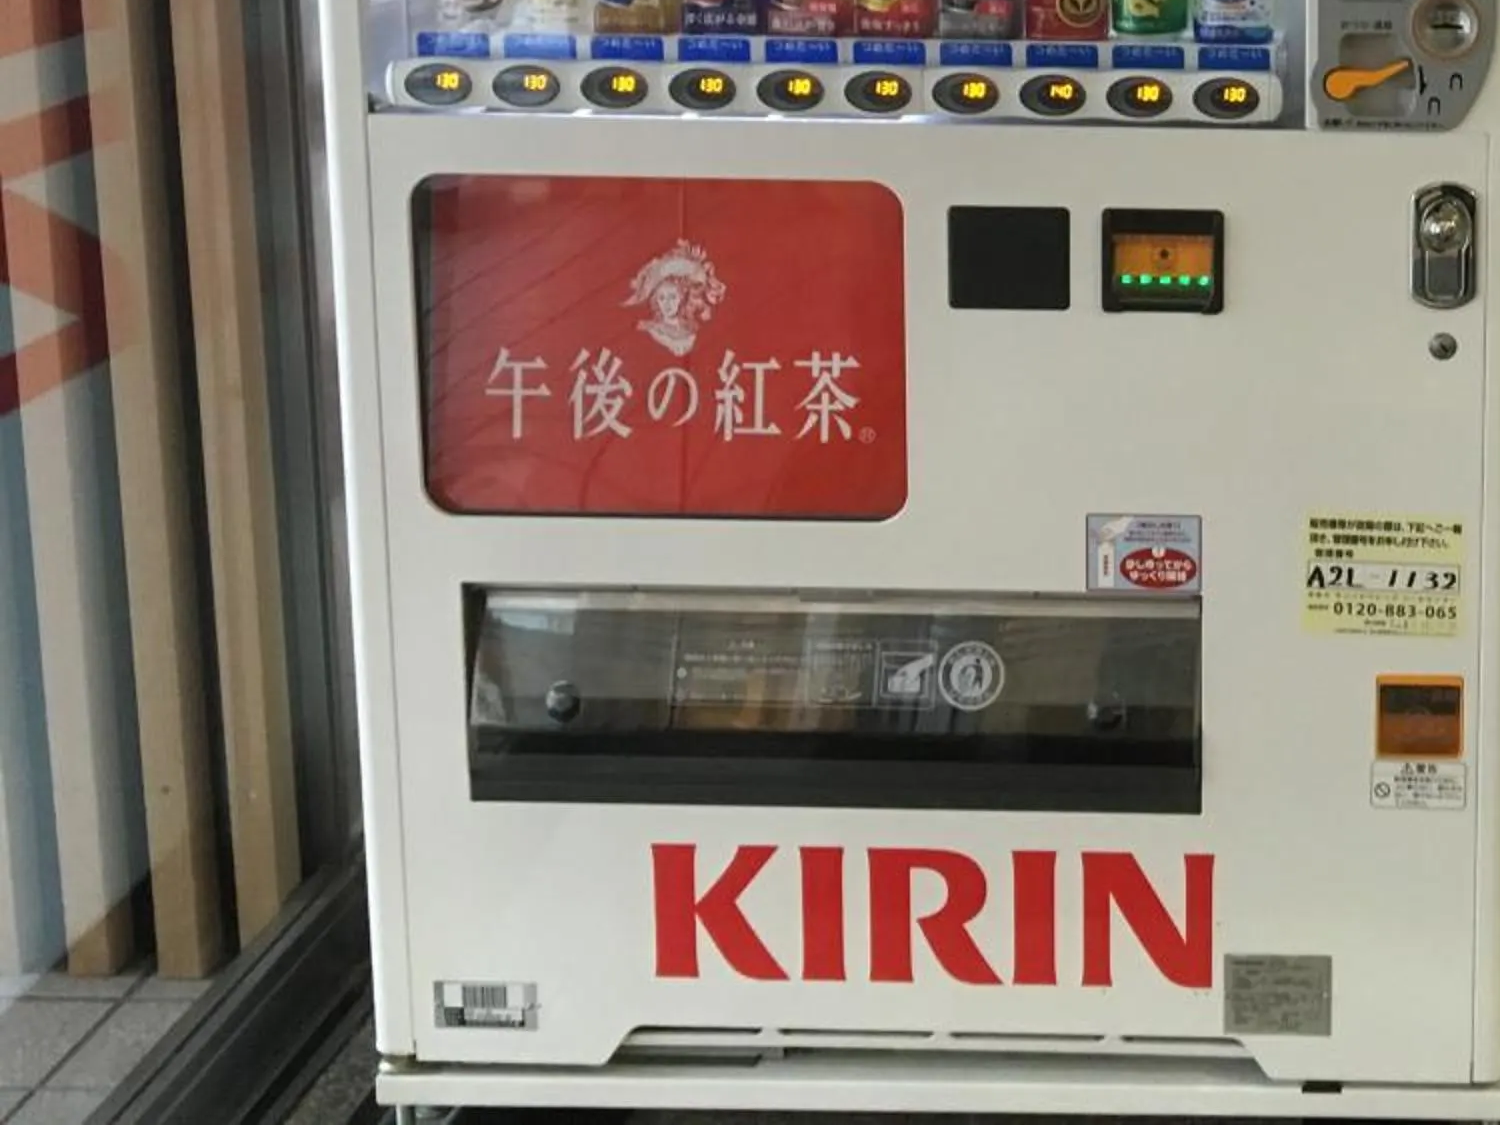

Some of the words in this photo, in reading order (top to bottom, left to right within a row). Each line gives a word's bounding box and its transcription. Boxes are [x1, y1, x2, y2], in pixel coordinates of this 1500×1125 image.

[525, 75, 547, 89] 130
[701, 79, 722, 92] 130
[877, 81, 898, 95] 130
[1051, 85, 1072, 98] 140
[1225, 88, 1245, 101] 130
[485, 347, 861, 444] 午後の紅茶
[1388, 569, 1457, 590] 1132
[1333, 602, 1457, 619] 0120-883-065
[651, 843, 1215, 988] KIRIN
